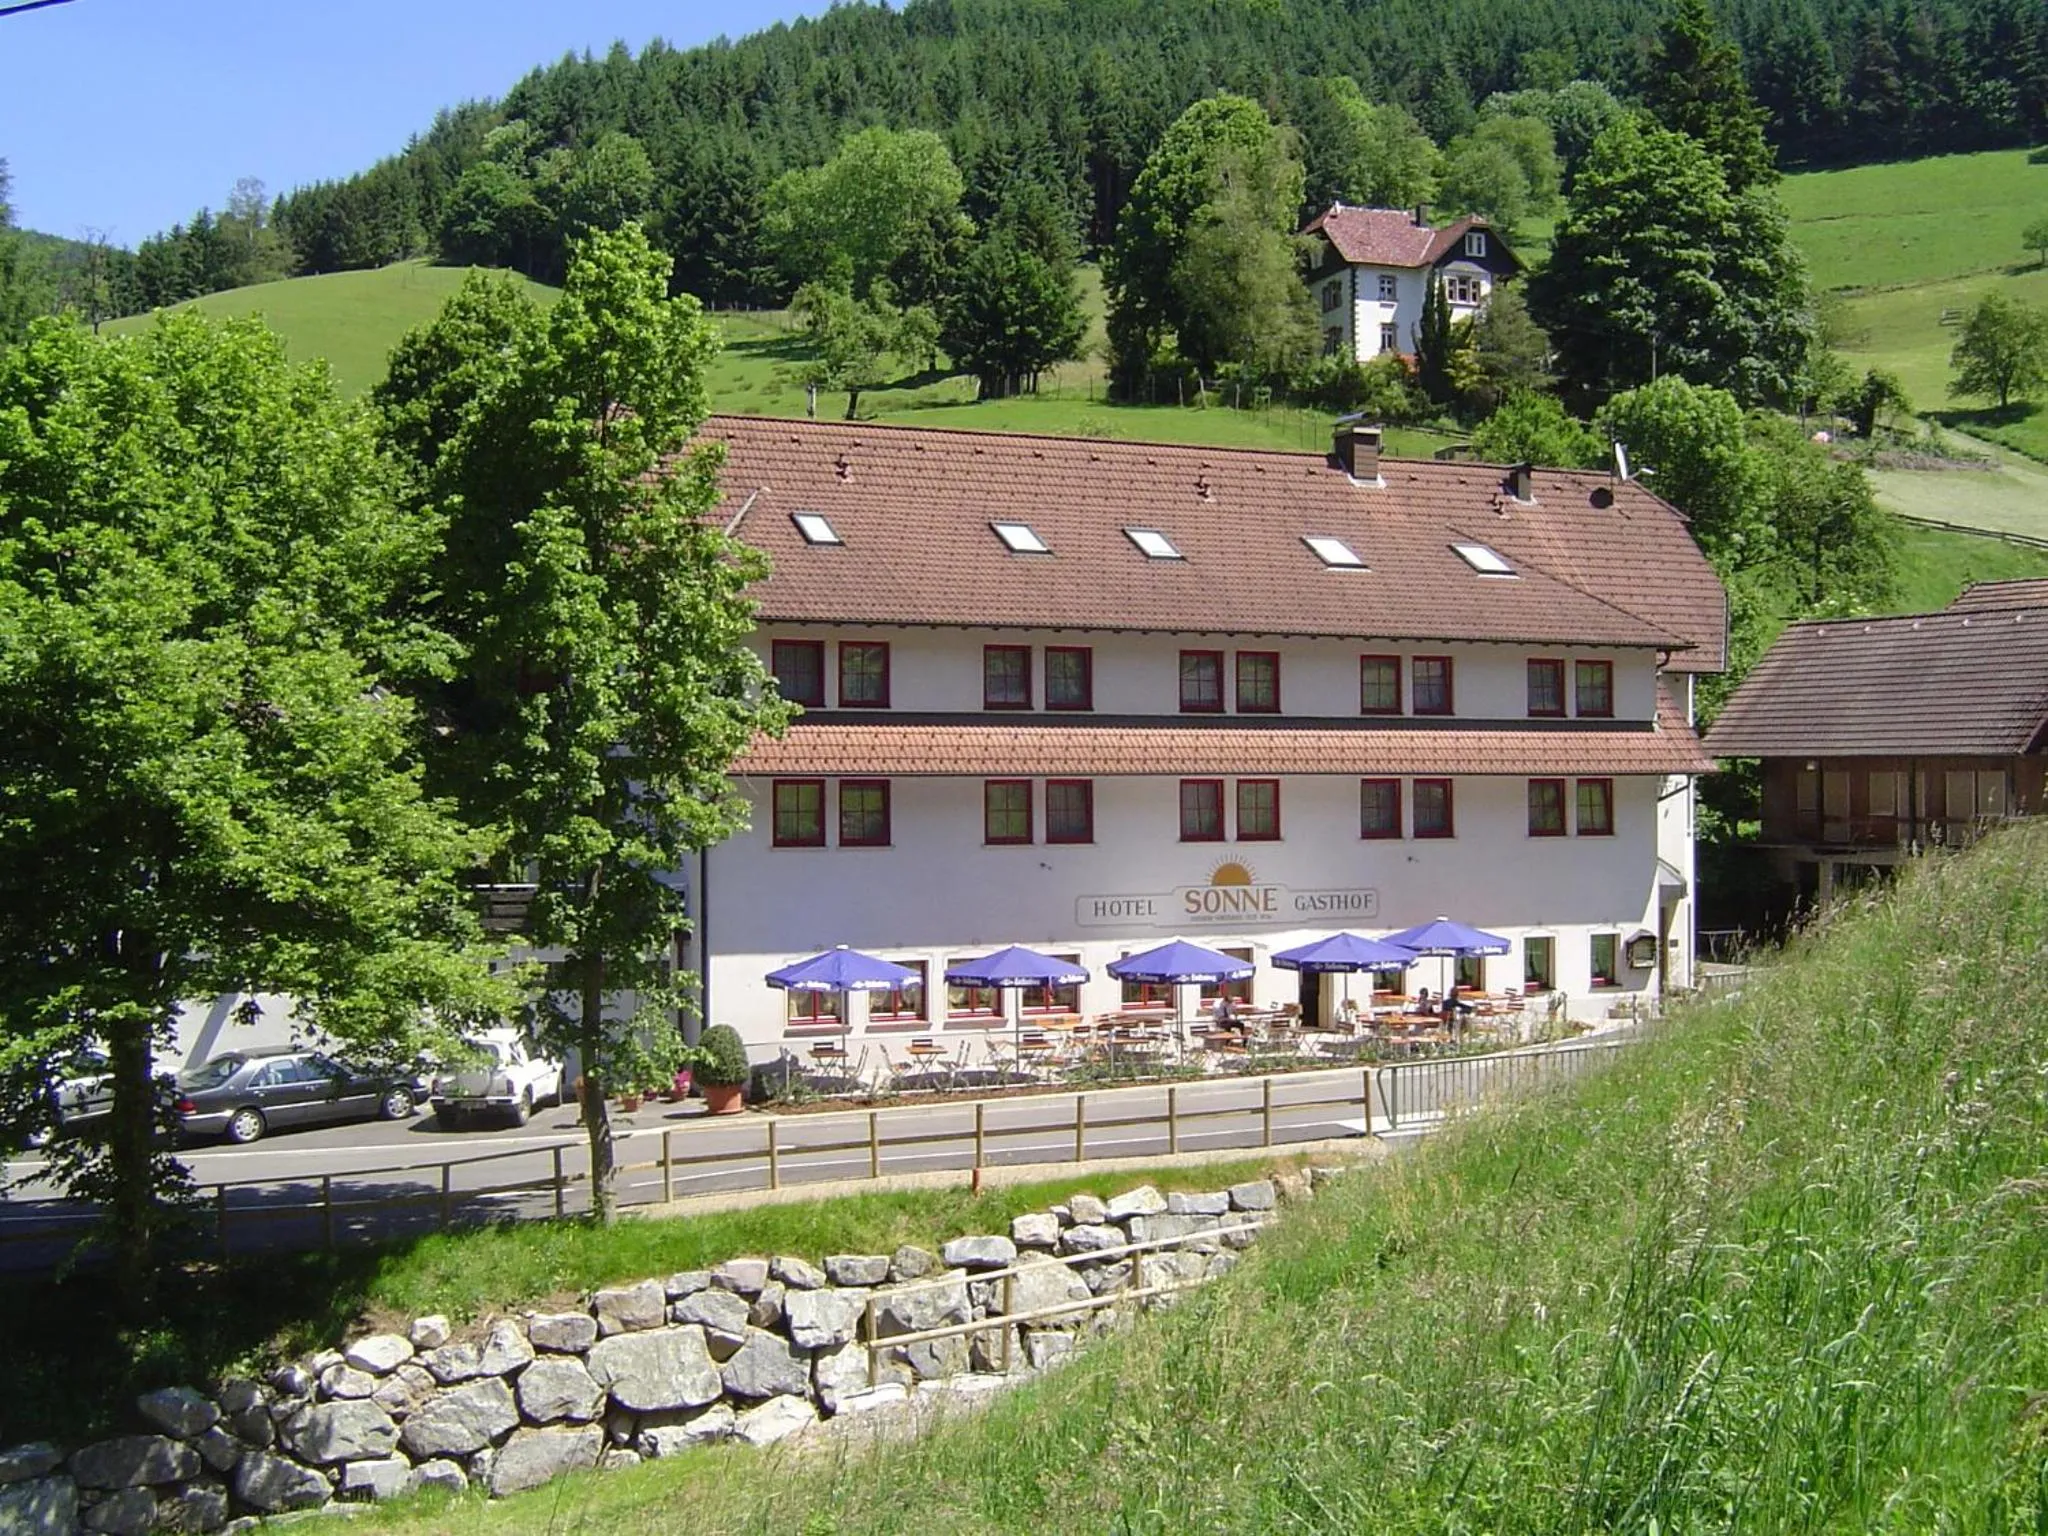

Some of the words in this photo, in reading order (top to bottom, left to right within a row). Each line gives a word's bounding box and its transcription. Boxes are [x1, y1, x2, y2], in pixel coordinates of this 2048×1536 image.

[1093, 899, 1158, 917] HOTEL
[1184, 887, 1278, 914] SONNE
[1294, 893, 1373, 911] GASTHOF
